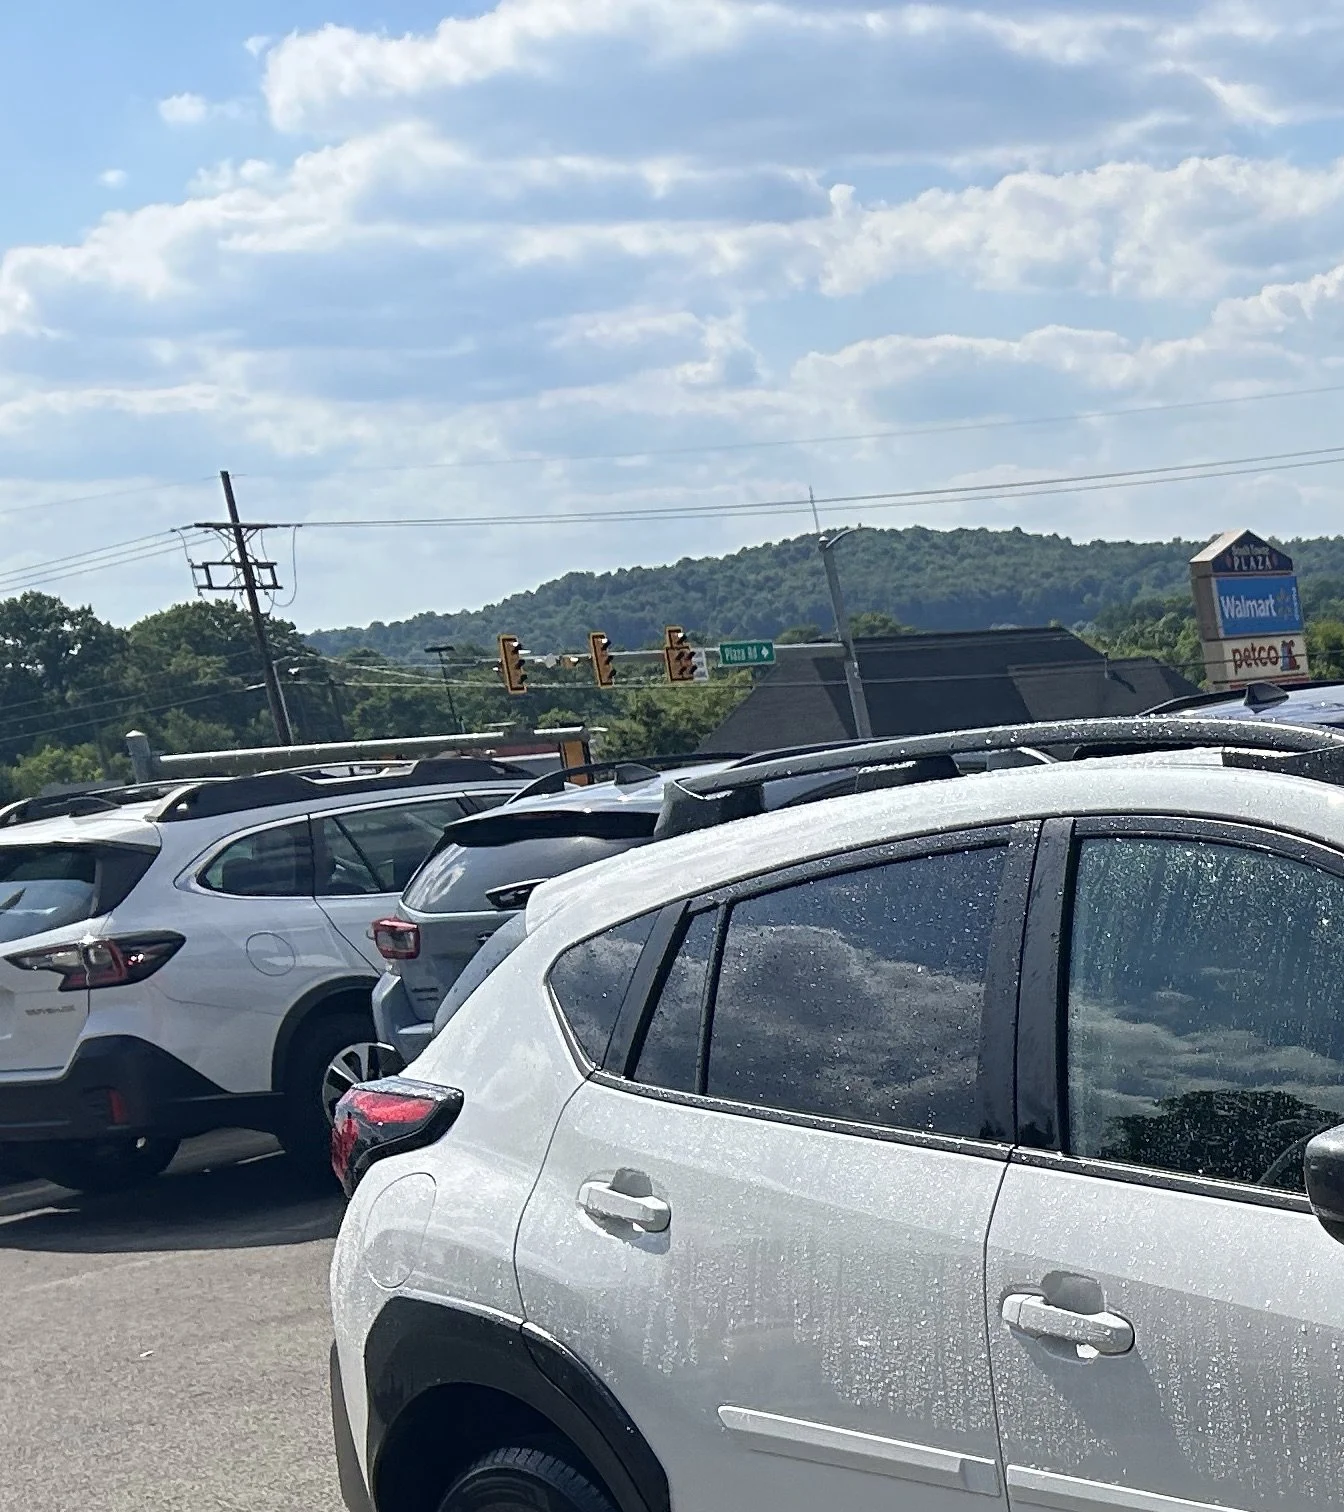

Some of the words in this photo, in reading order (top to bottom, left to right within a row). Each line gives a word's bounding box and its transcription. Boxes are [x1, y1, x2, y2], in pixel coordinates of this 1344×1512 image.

[1233, 555, 1272, 570] PLAZA
[1220, 594, 1277, 619] Walmart
[1231, 643, 1280, 675] petco
